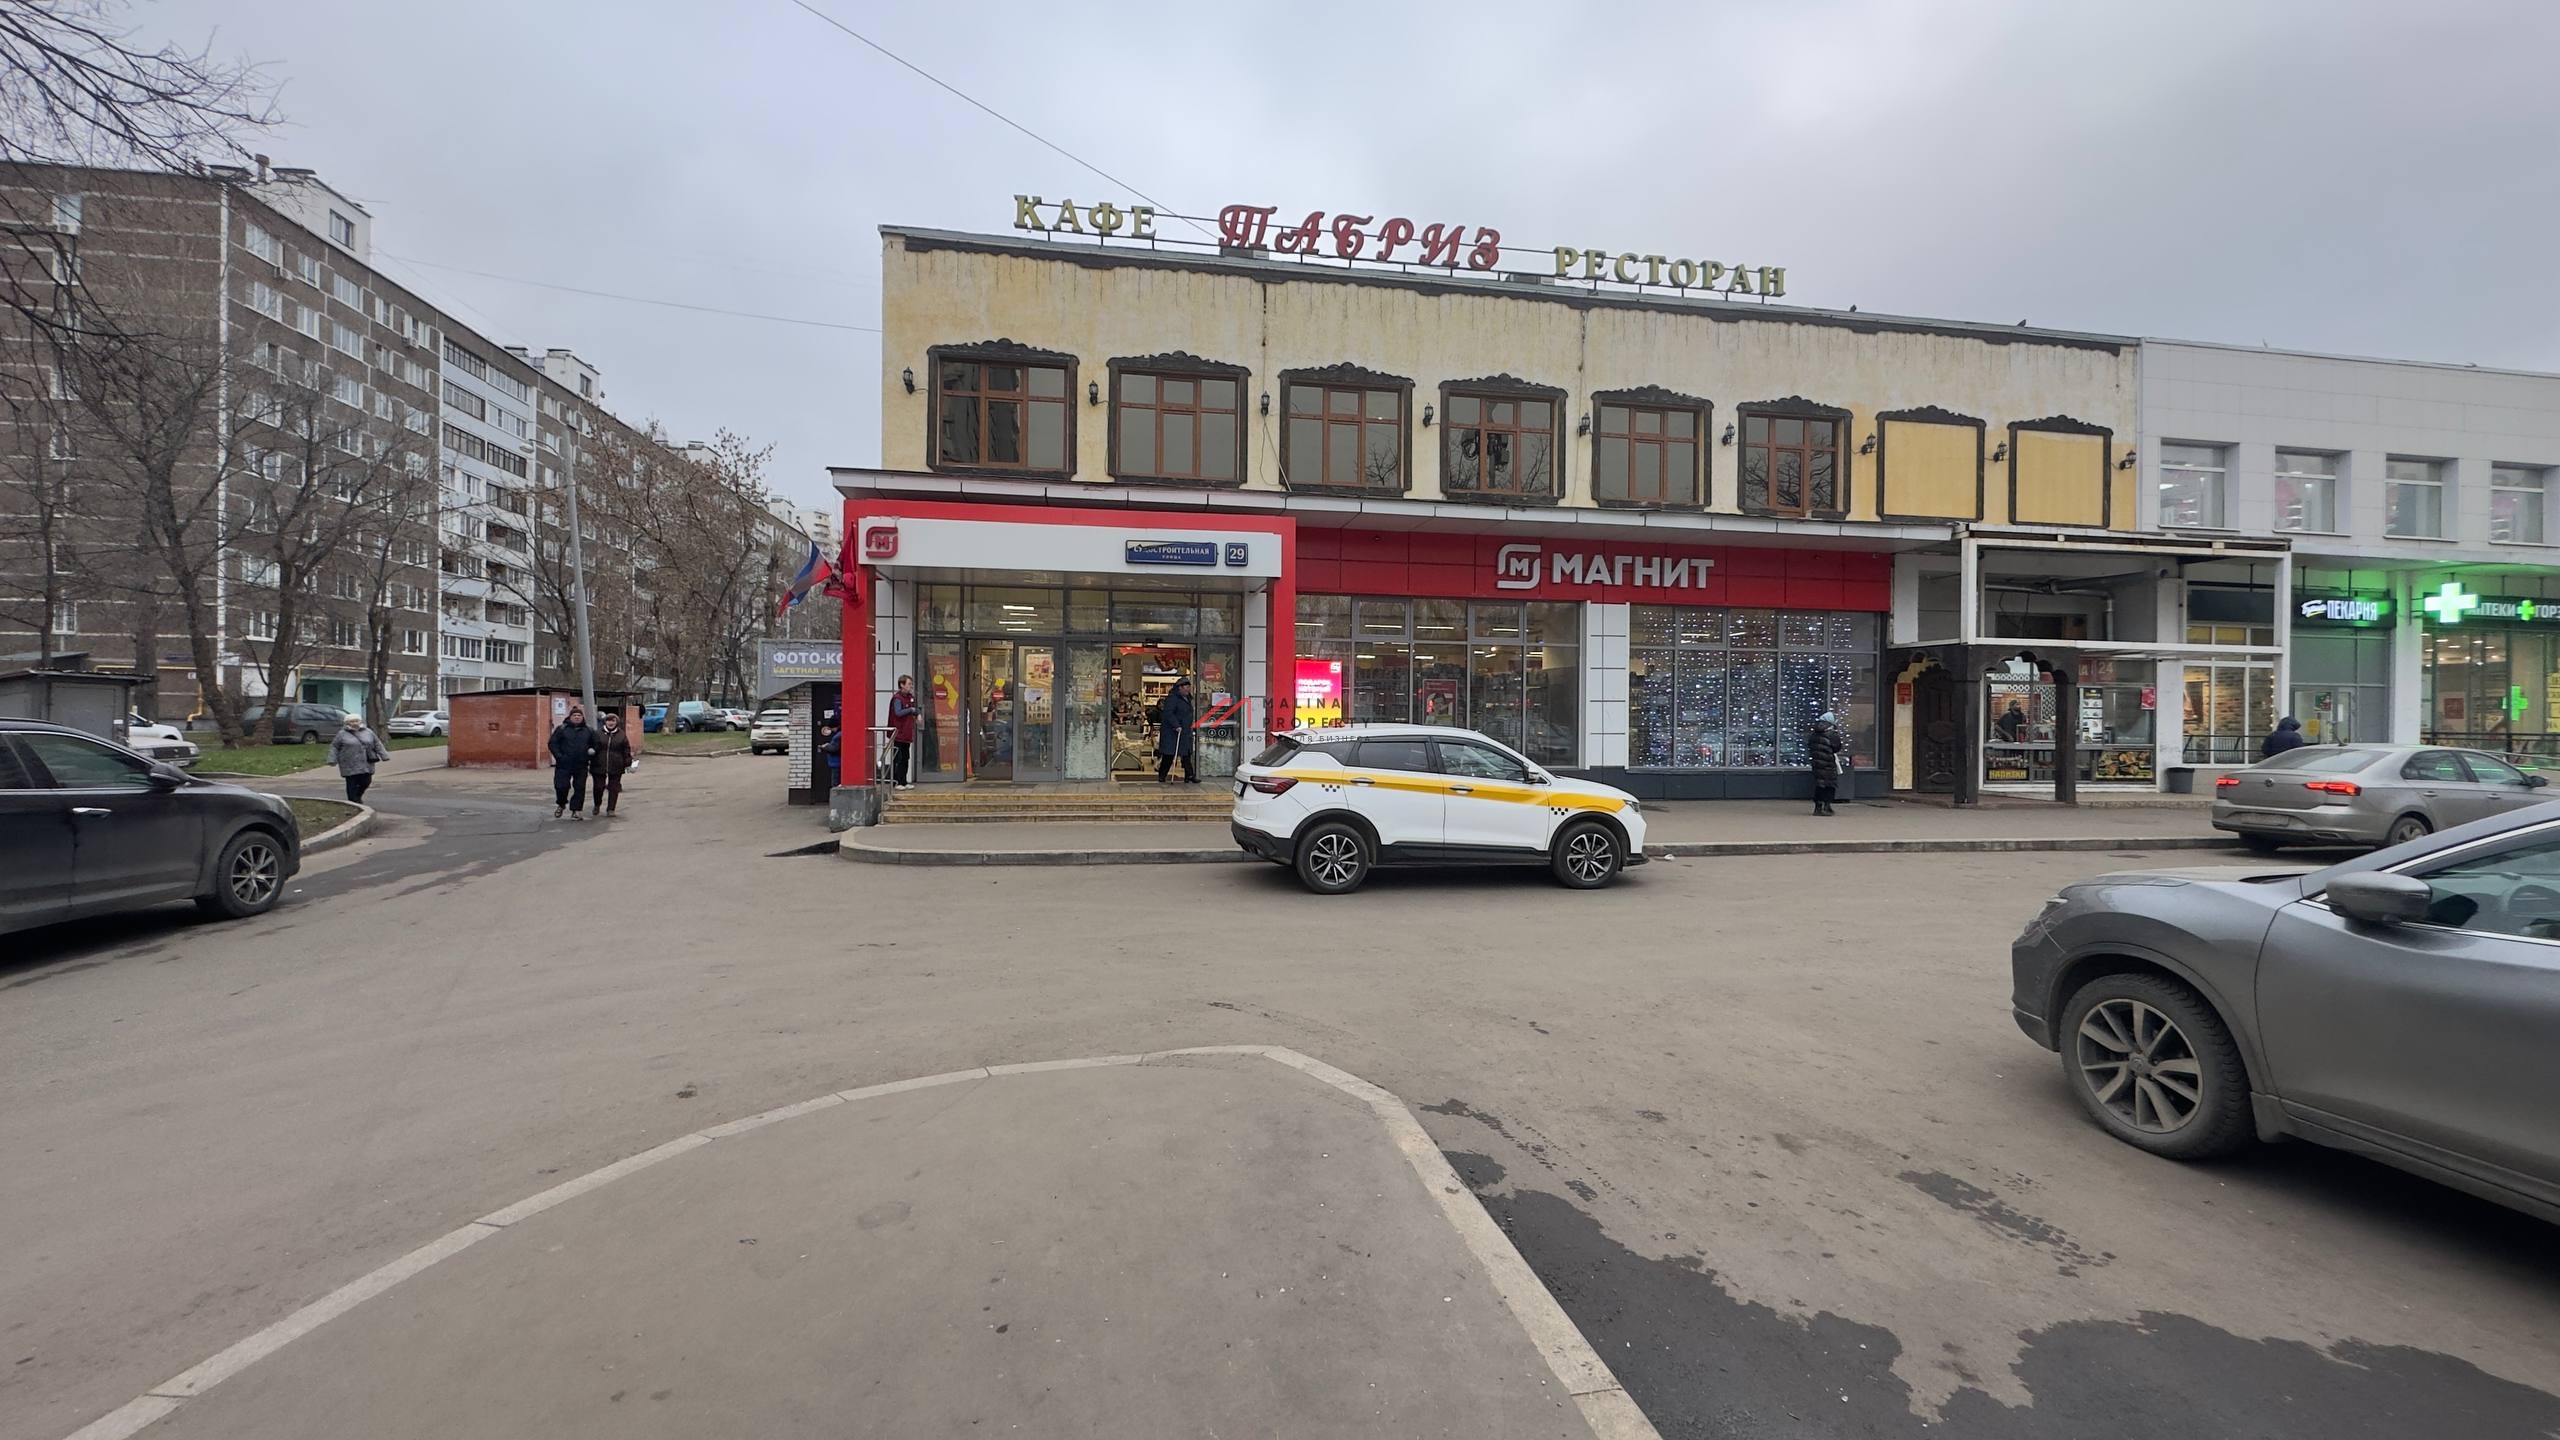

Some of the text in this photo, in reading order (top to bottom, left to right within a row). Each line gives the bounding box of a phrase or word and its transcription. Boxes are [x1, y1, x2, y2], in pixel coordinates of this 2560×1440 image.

[1013, 194, 1157, 239] КАФЕ
[1218, 204, 1501, 272] ТАБРИЗ
[1553, 245, 1787, 298] РЕСТОРАН
[1133, 545, 1210, 555] СУОСТРОИТЕЛЬНАЯ
[1229, 547, 1245, 560] 29
[1552, 552, 1715, 590] МАГНИТ
[2326, 600, 2378, 621] ПЕКАРНЯ
